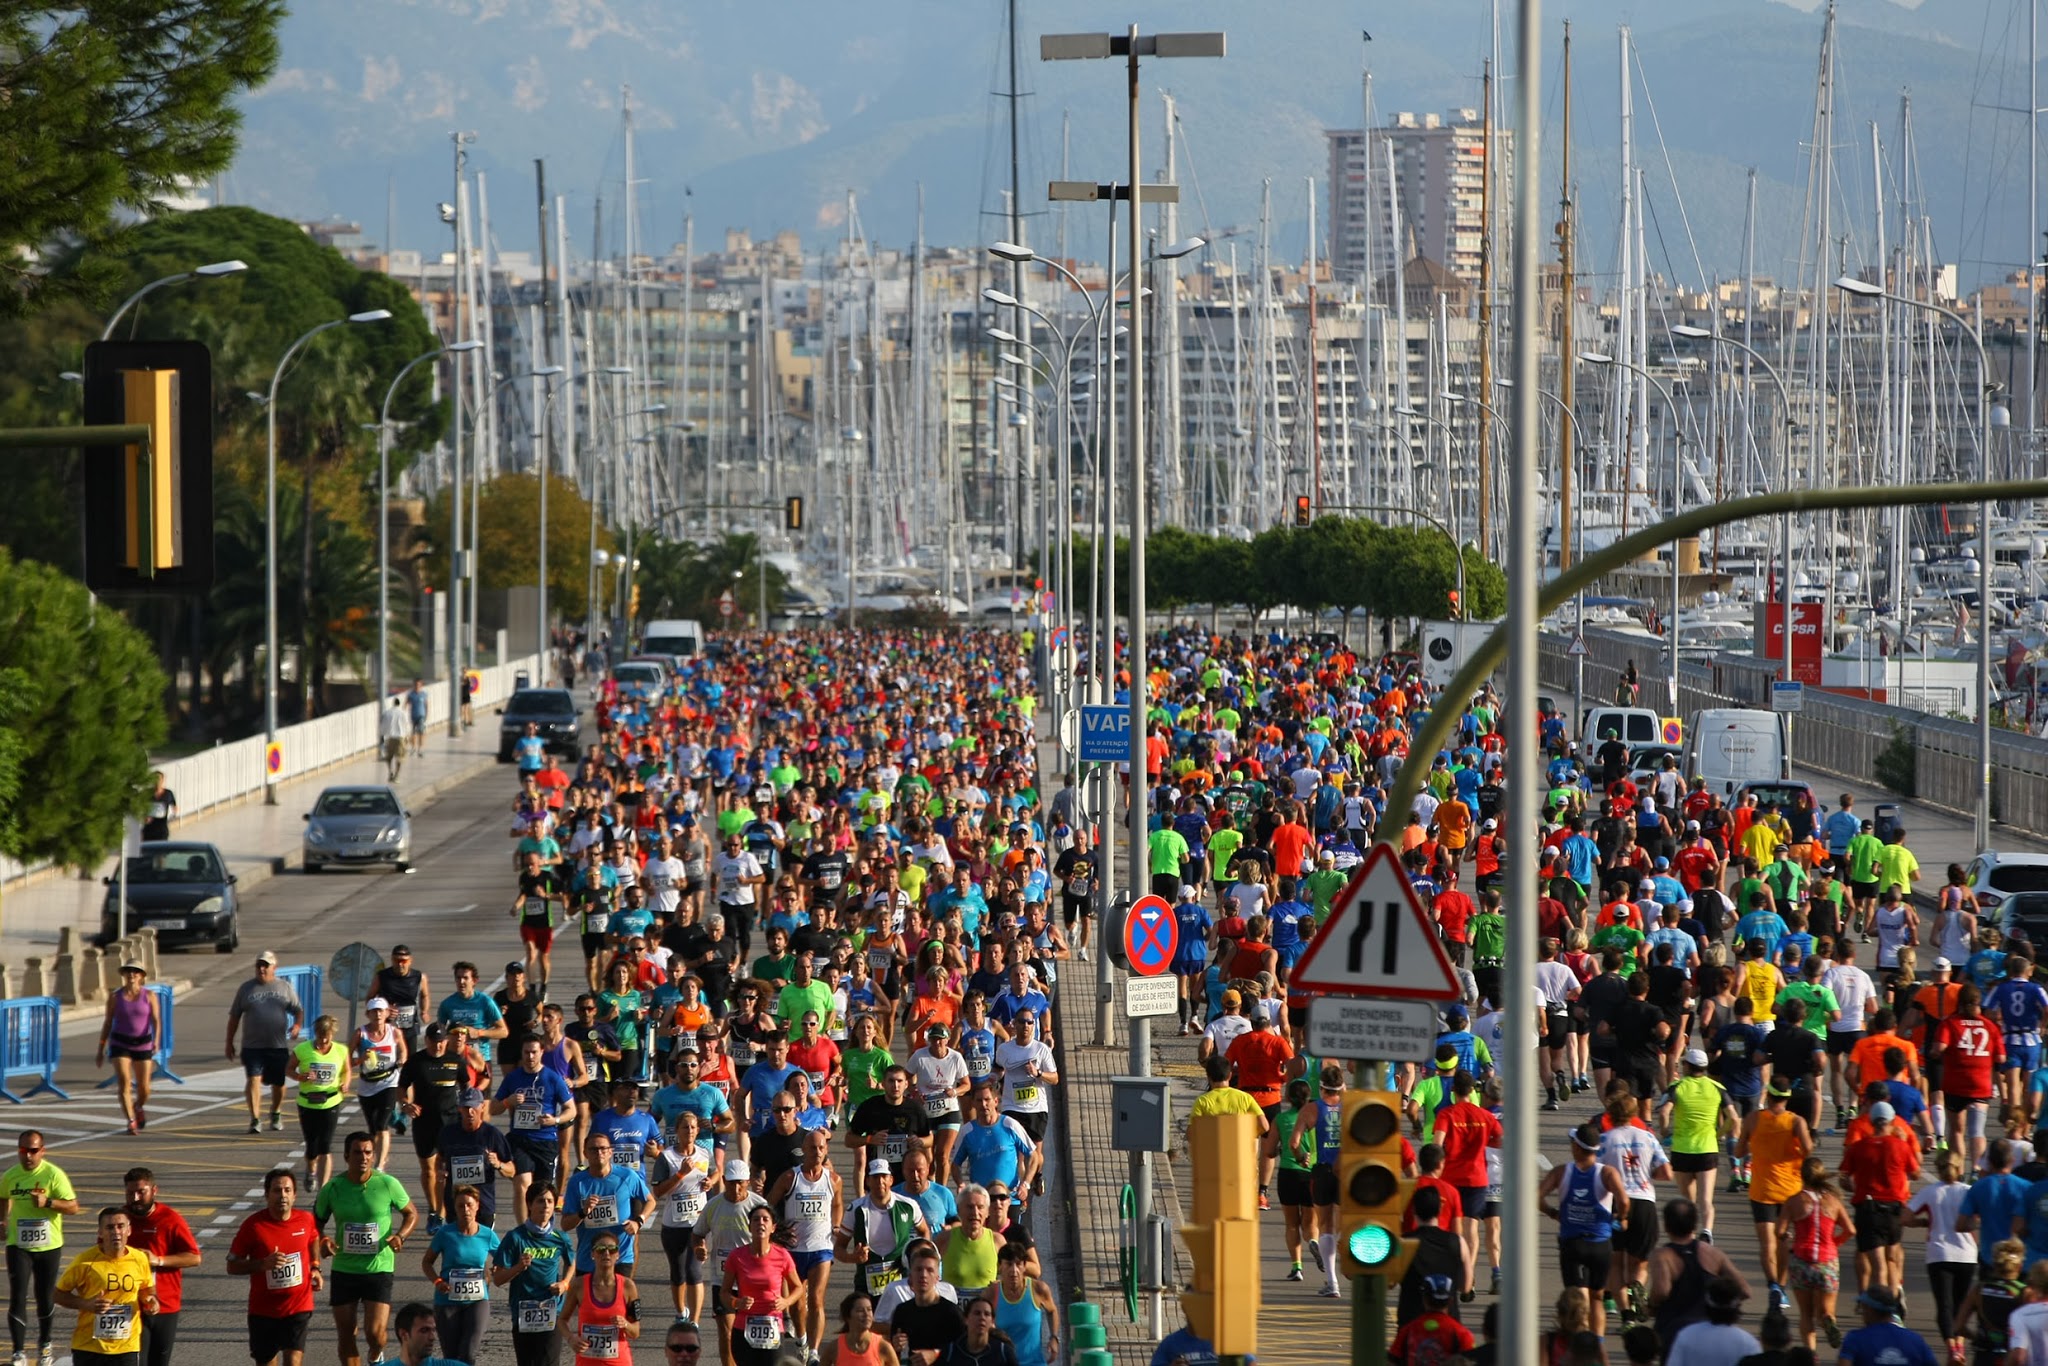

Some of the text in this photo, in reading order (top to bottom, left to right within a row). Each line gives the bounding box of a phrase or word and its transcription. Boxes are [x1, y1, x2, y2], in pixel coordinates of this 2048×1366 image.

[1773, 623, 1816, 635] CPSA
[1084, 713, 1130, 732] VAP
[1129, 981, 1175, 991] EXCEPTE DIVENDRES
[1150, 992, 1156, 1000] DE
[1157, 991, 1175, 999] FESTIUS
[1139, 1003, 1150, 1011] 22:00
[2010, 990, 2025, 1017] 8
[1340, 1007, 1403, 1022] DIVENDRES
[1366, 1024, 1381, 1036] DE
[1384, 1026, 1428, 1039] FESTIUS
[1320, 1037, 1336, 1048] DE
[1957, 1027, 1991, 1057] 42
[1016, 1087, 1036, 1101] 1179
[518, 1110, 536, 1122] 7975
[613, 1152, 635, 1164] 6501
[456, 1165, 482, 1180] 8054
[676, 1199, 700, 1213] 8195
[800, 1201, 823, 1215] 7212
[20, 1228, 47, 1242] 8395
[348, 1232, 373, 1247] 6965
[272, 1264, 296, 1280] 6507
[107, 1273, 136, 1292] BO
[454, 1280, 481, 1296] 6595
[100, 1316, 126, 1330] 6372
[750, 1326, 776, 1342] 8193
